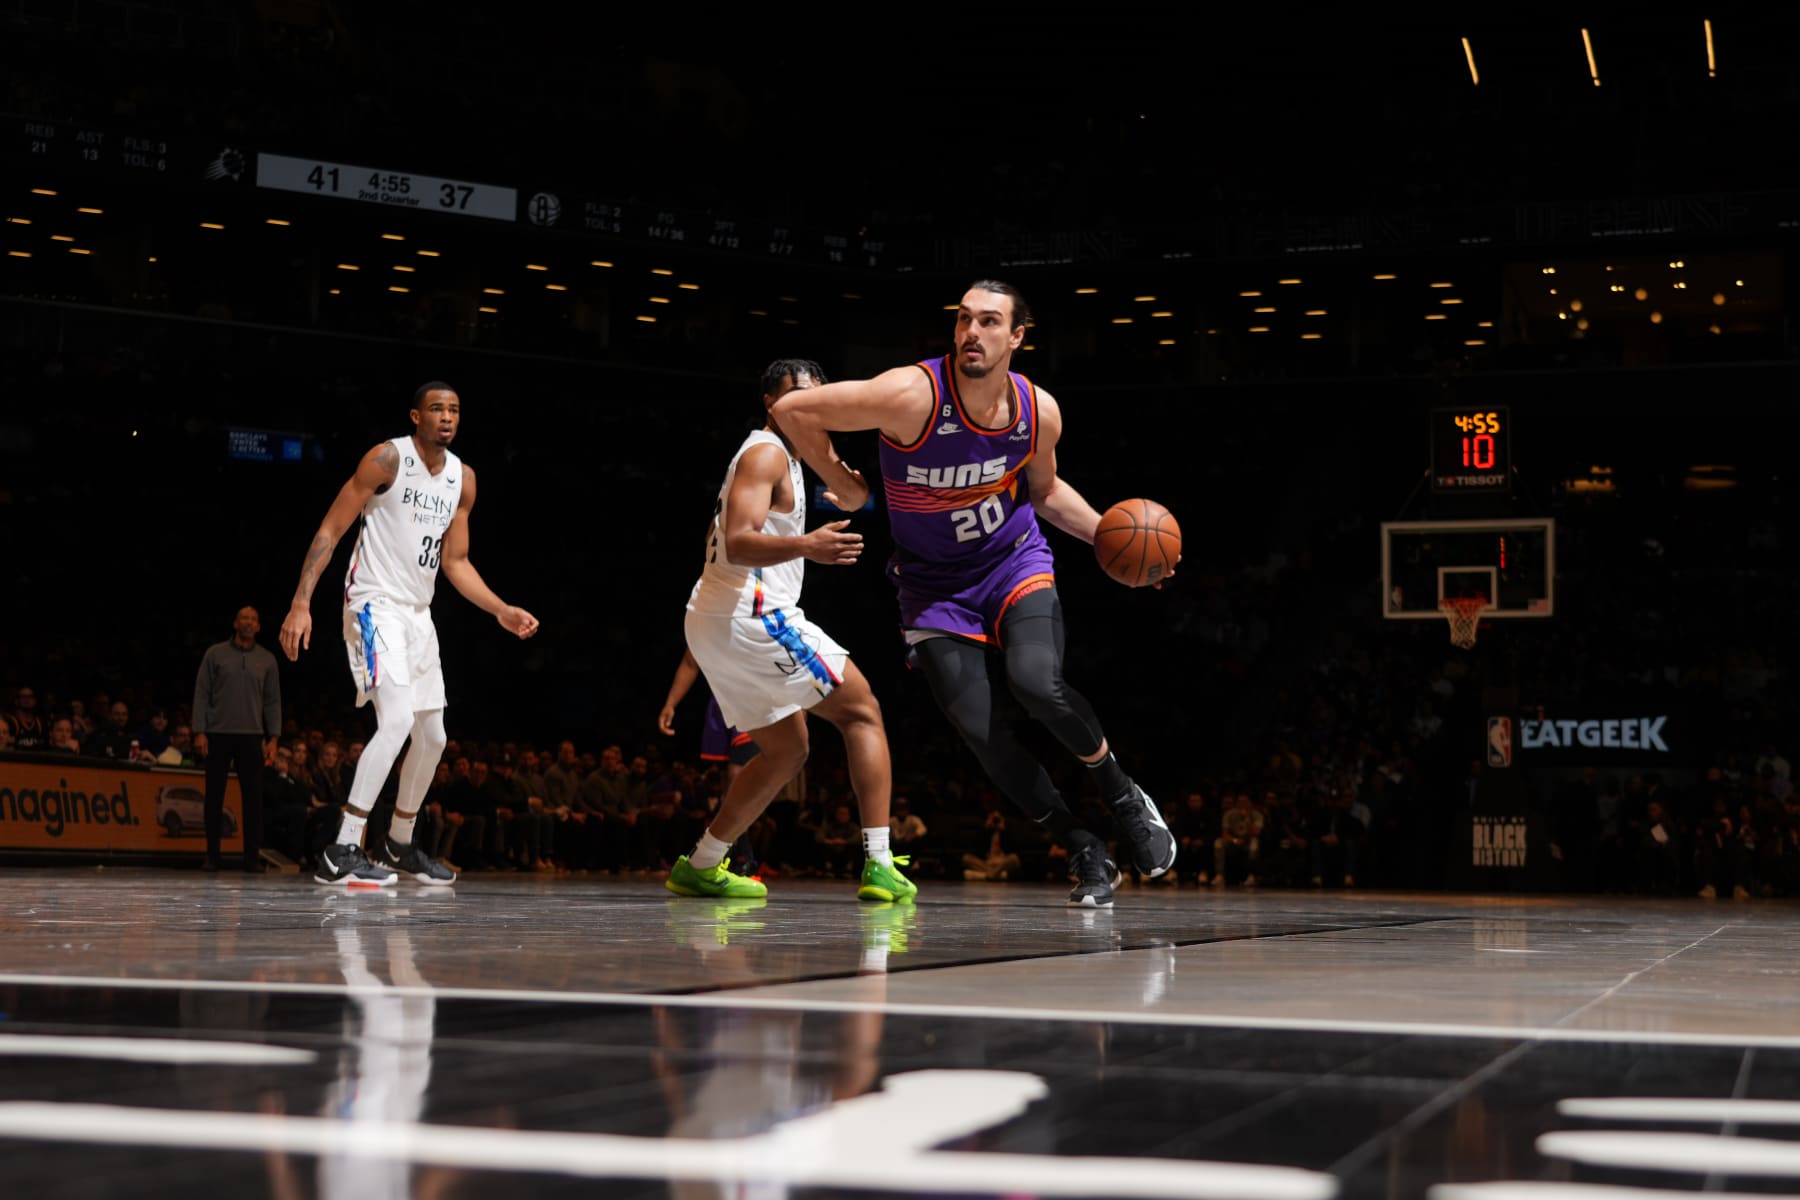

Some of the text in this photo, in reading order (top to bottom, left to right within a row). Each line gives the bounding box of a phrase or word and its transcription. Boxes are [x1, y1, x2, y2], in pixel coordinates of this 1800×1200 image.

[75, 130, 105, 144] AST
[31, 141, 47, 153] 21
[82, 148, 99, 161] 13
[158, 141, 168, 154] 3
[157, 158, 167, 172] 6
[307, 165, 340, 192] 41
[368, 172, 411, 194] 4:55
[358, 189, 420, 205] 2nd Quarter
[439, 184, 475, 210] 37
[613, 206, 623, 218] 2
[942, 404, 952, 417] 6
[1454, 412, 1501, 434] 4:55
[1008, 434, 1030, 442] PayPal
[1462, 433, 1496, 470] 10
[906, 455, 1008, 488] SUNS
[1456, 474, 1505, 486] TISSOT
[401, 487, 452, 514] BKLYN
[951, 494, 1005, 543] 20
[1472, 824, 1527, 849] BLACK
[1472, 848, 1527, 867] HISTORY
